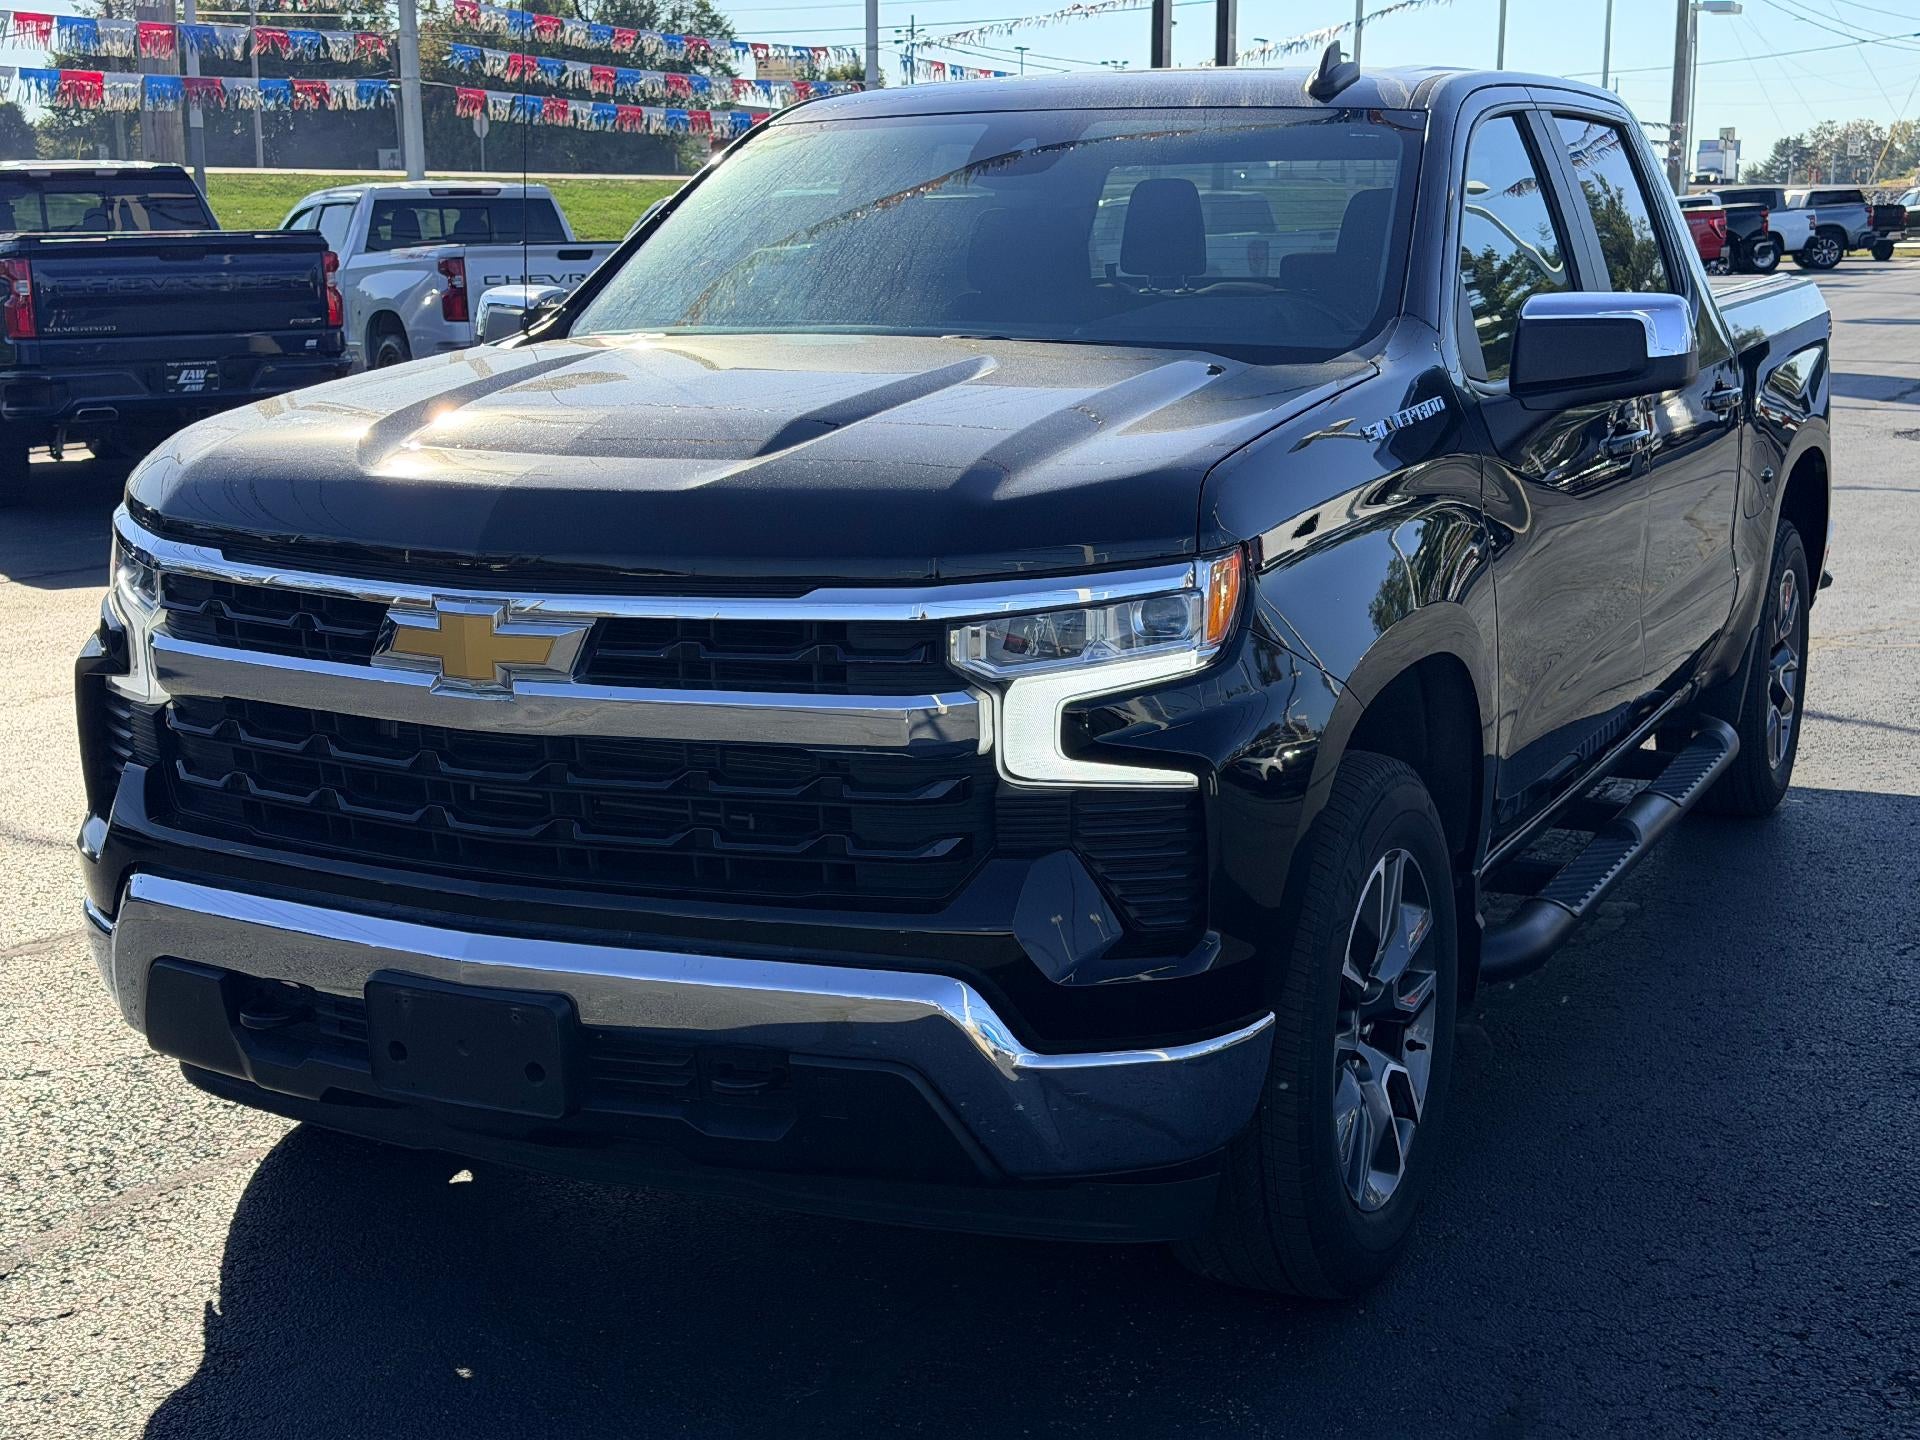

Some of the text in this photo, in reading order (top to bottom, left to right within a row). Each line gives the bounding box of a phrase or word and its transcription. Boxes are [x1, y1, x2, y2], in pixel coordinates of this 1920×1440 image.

[483, 273, 588, 286] CHEVR
[177, 369, 208, 384] LAW
[1360, 396, 1447, 442] SILVERADO
